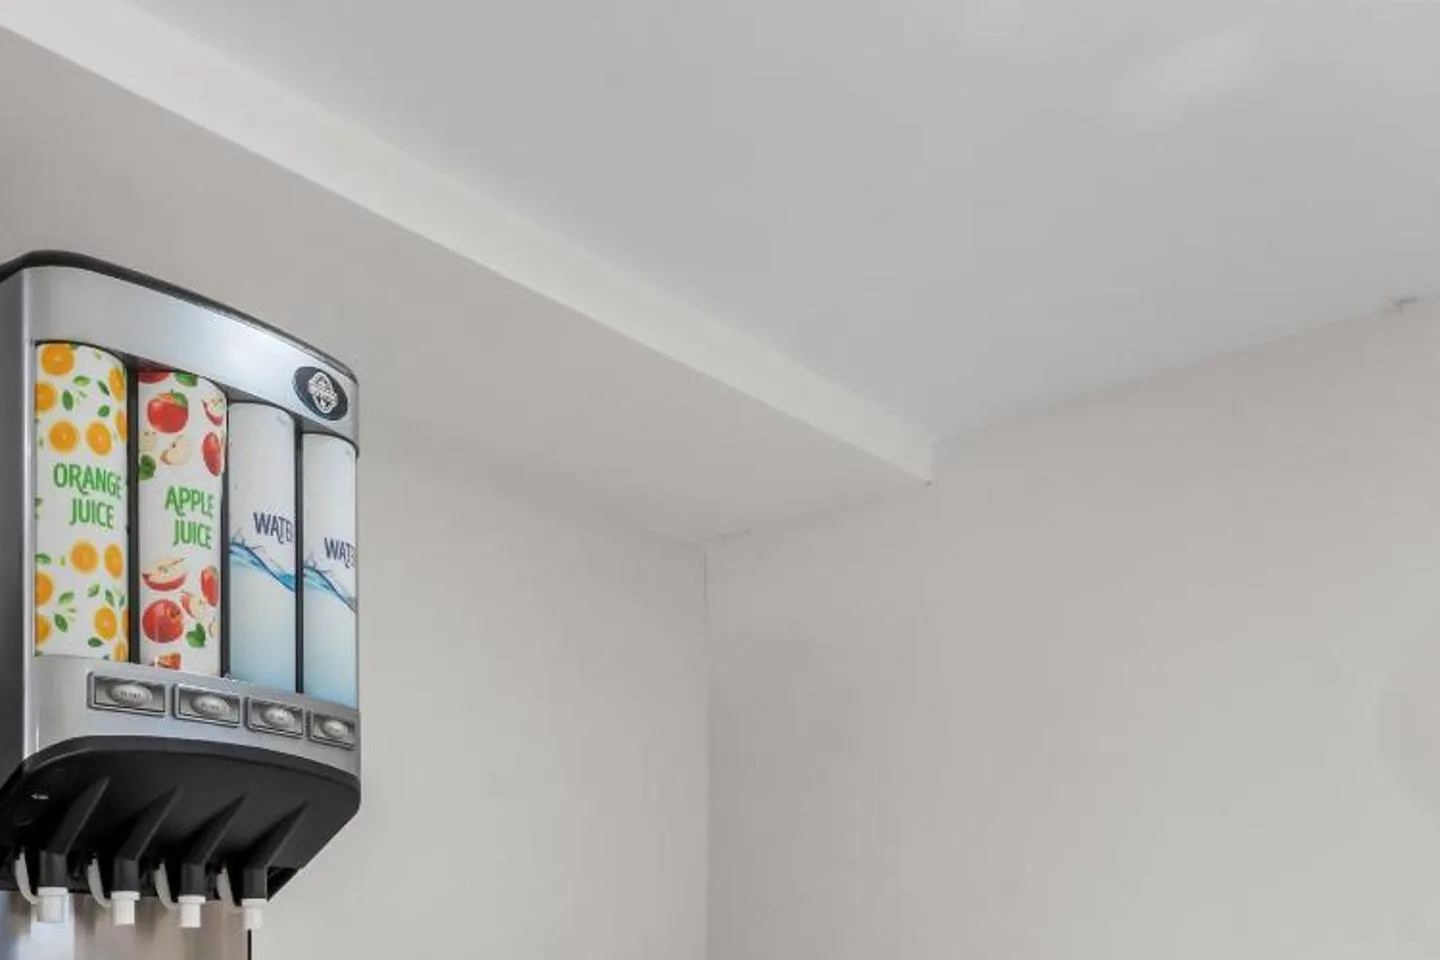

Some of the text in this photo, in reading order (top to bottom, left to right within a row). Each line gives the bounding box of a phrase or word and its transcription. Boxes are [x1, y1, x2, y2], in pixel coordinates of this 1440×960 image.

[53, 462, 122, 500] ORANGE
[69, 497, 115, 530] JUICE
[164, 485, 213, 519] APPLE
[172, 519, 213, 550] JUICE
